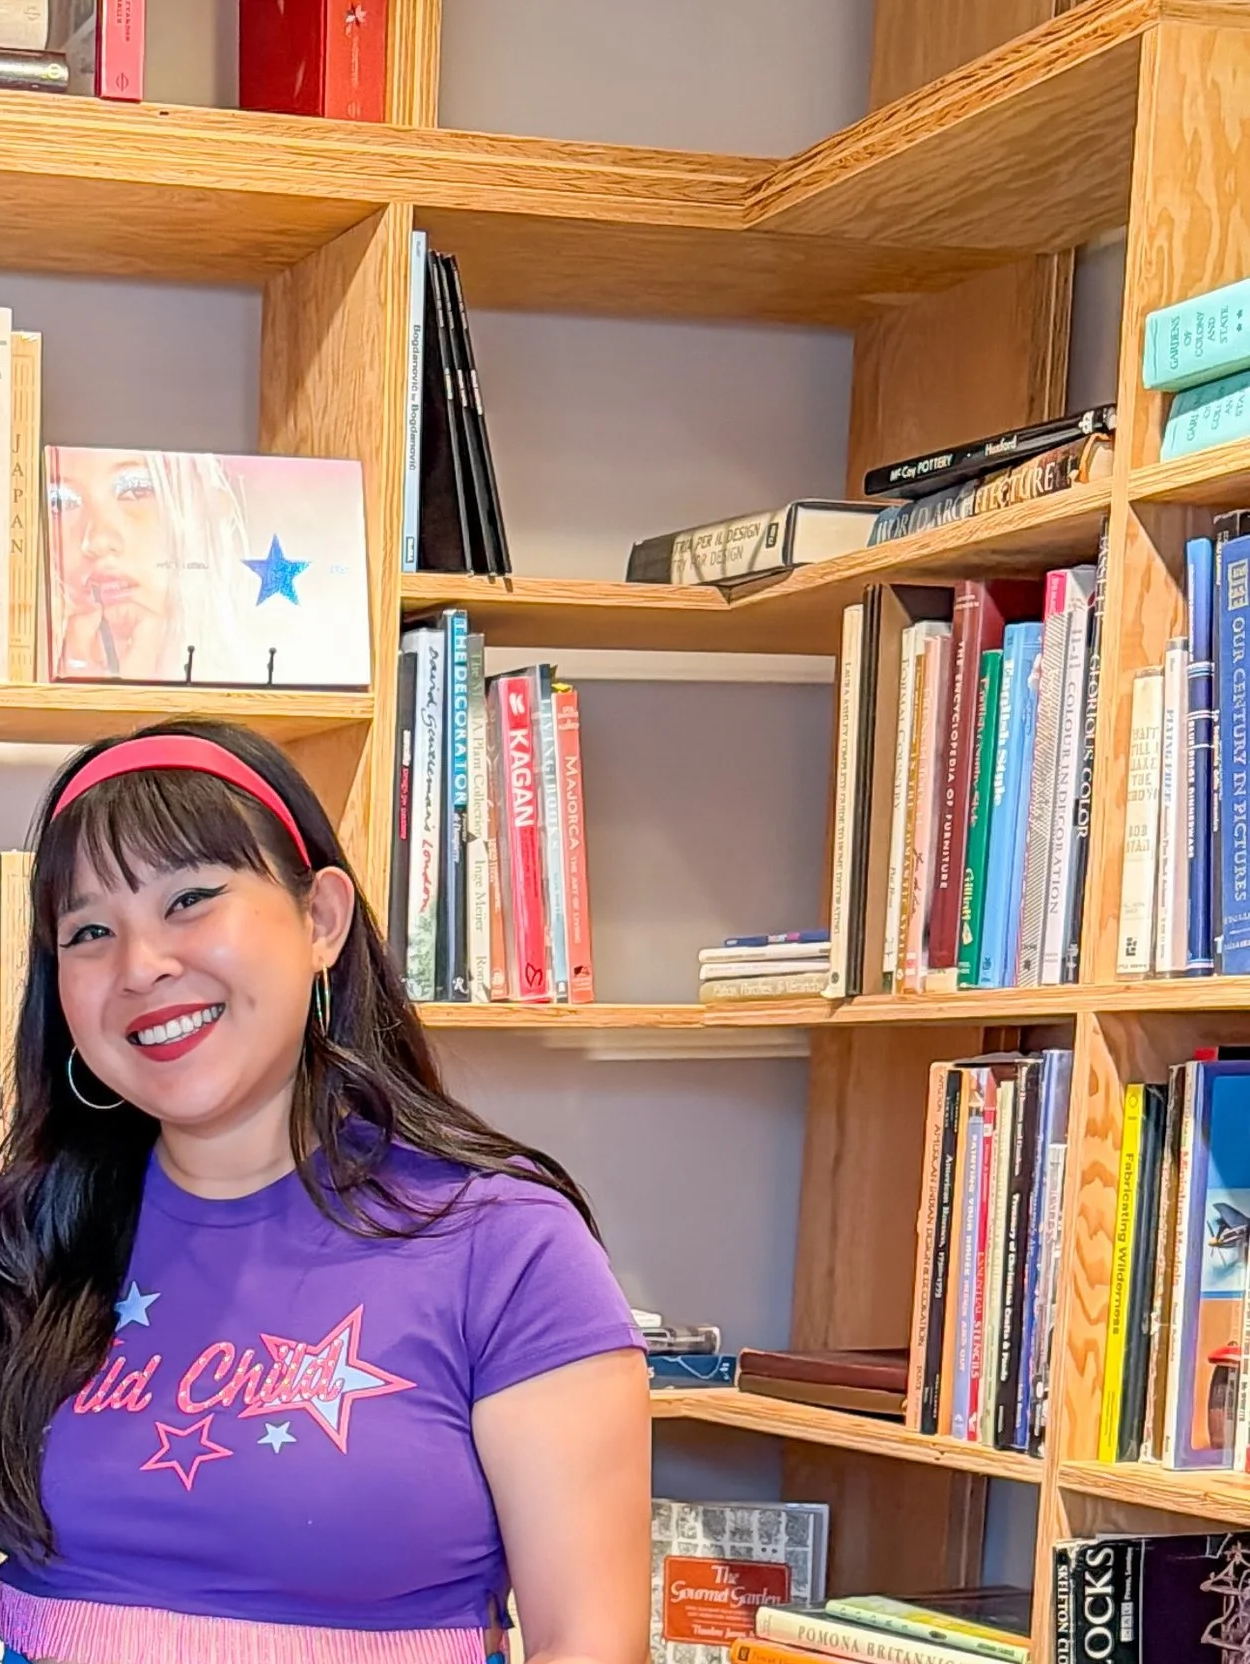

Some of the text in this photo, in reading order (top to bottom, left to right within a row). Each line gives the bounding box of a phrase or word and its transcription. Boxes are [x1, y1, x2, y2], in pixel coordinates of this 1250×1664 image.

[1183, 330, 1193, 347] OF
[1207, 316, 1216, 342] AND
[1219, 305, 1229, 344] STATE
[917, 454, 954, 474] POTTERY
[10, 433, 24, 555] JAPAN
[874, 461, 1055, 543] WORLD ARCHITECTURE
[695, 531, 712, 549] PER
[726, 521, 762, 544] DESIGN
[710, 544, 744, 566] DESIGN
[1232, 616, 1246, 665] OUR
[453, 616, 469, 806] THE DECORATOR
[897, 657, 909, 725] FORMAL
[1232, 670, 1247, 766] CENTURY
[994, 658, 1015, 808] English Style
[1061, 681, 1077, 761] COLOUR
[1076, 652, 1100, 839] GLORIOUS COLOR
[472, 737, 484, 770] Plant
[508, 727, 534, 829] KAGAN
[940, 640, 965, 890] THE ENCYCLOPEDIA OF FURNITURE
[1060, 764, 1070, 784] IN
[472, 773, 484, 839] Collection
[562, 755, 580, 851] MAJORCA
[1233, 773, 1247, 797] IN
[419, 838, 434, 914] London
[473, 859, 485, 887] Inge
[570, 856, 578, 875] THE
[1049, 788, 1069, 915] DECORATION
[1232, 803, 1248, 902] PICTURES
[474, 890, 485, 934] Meijer
[572, 911, 581, 945] LIVING
[942, 1153, 954, 1204] American
[1116, 1152, 1136, 1244] Fabricating
[966, 1197, 974, 1232] YOUR
[1004, 1253, 1017, 1306] Christmas
[73, 1339, 345, 1415] ild Child
[970, 1319, 983, 1380] STENCILS
[711, 1564, 740, 1585] The
[1058, 1564, 1070, 1633] SKELETON
[797, 1625, 860, 1653] POMONA
